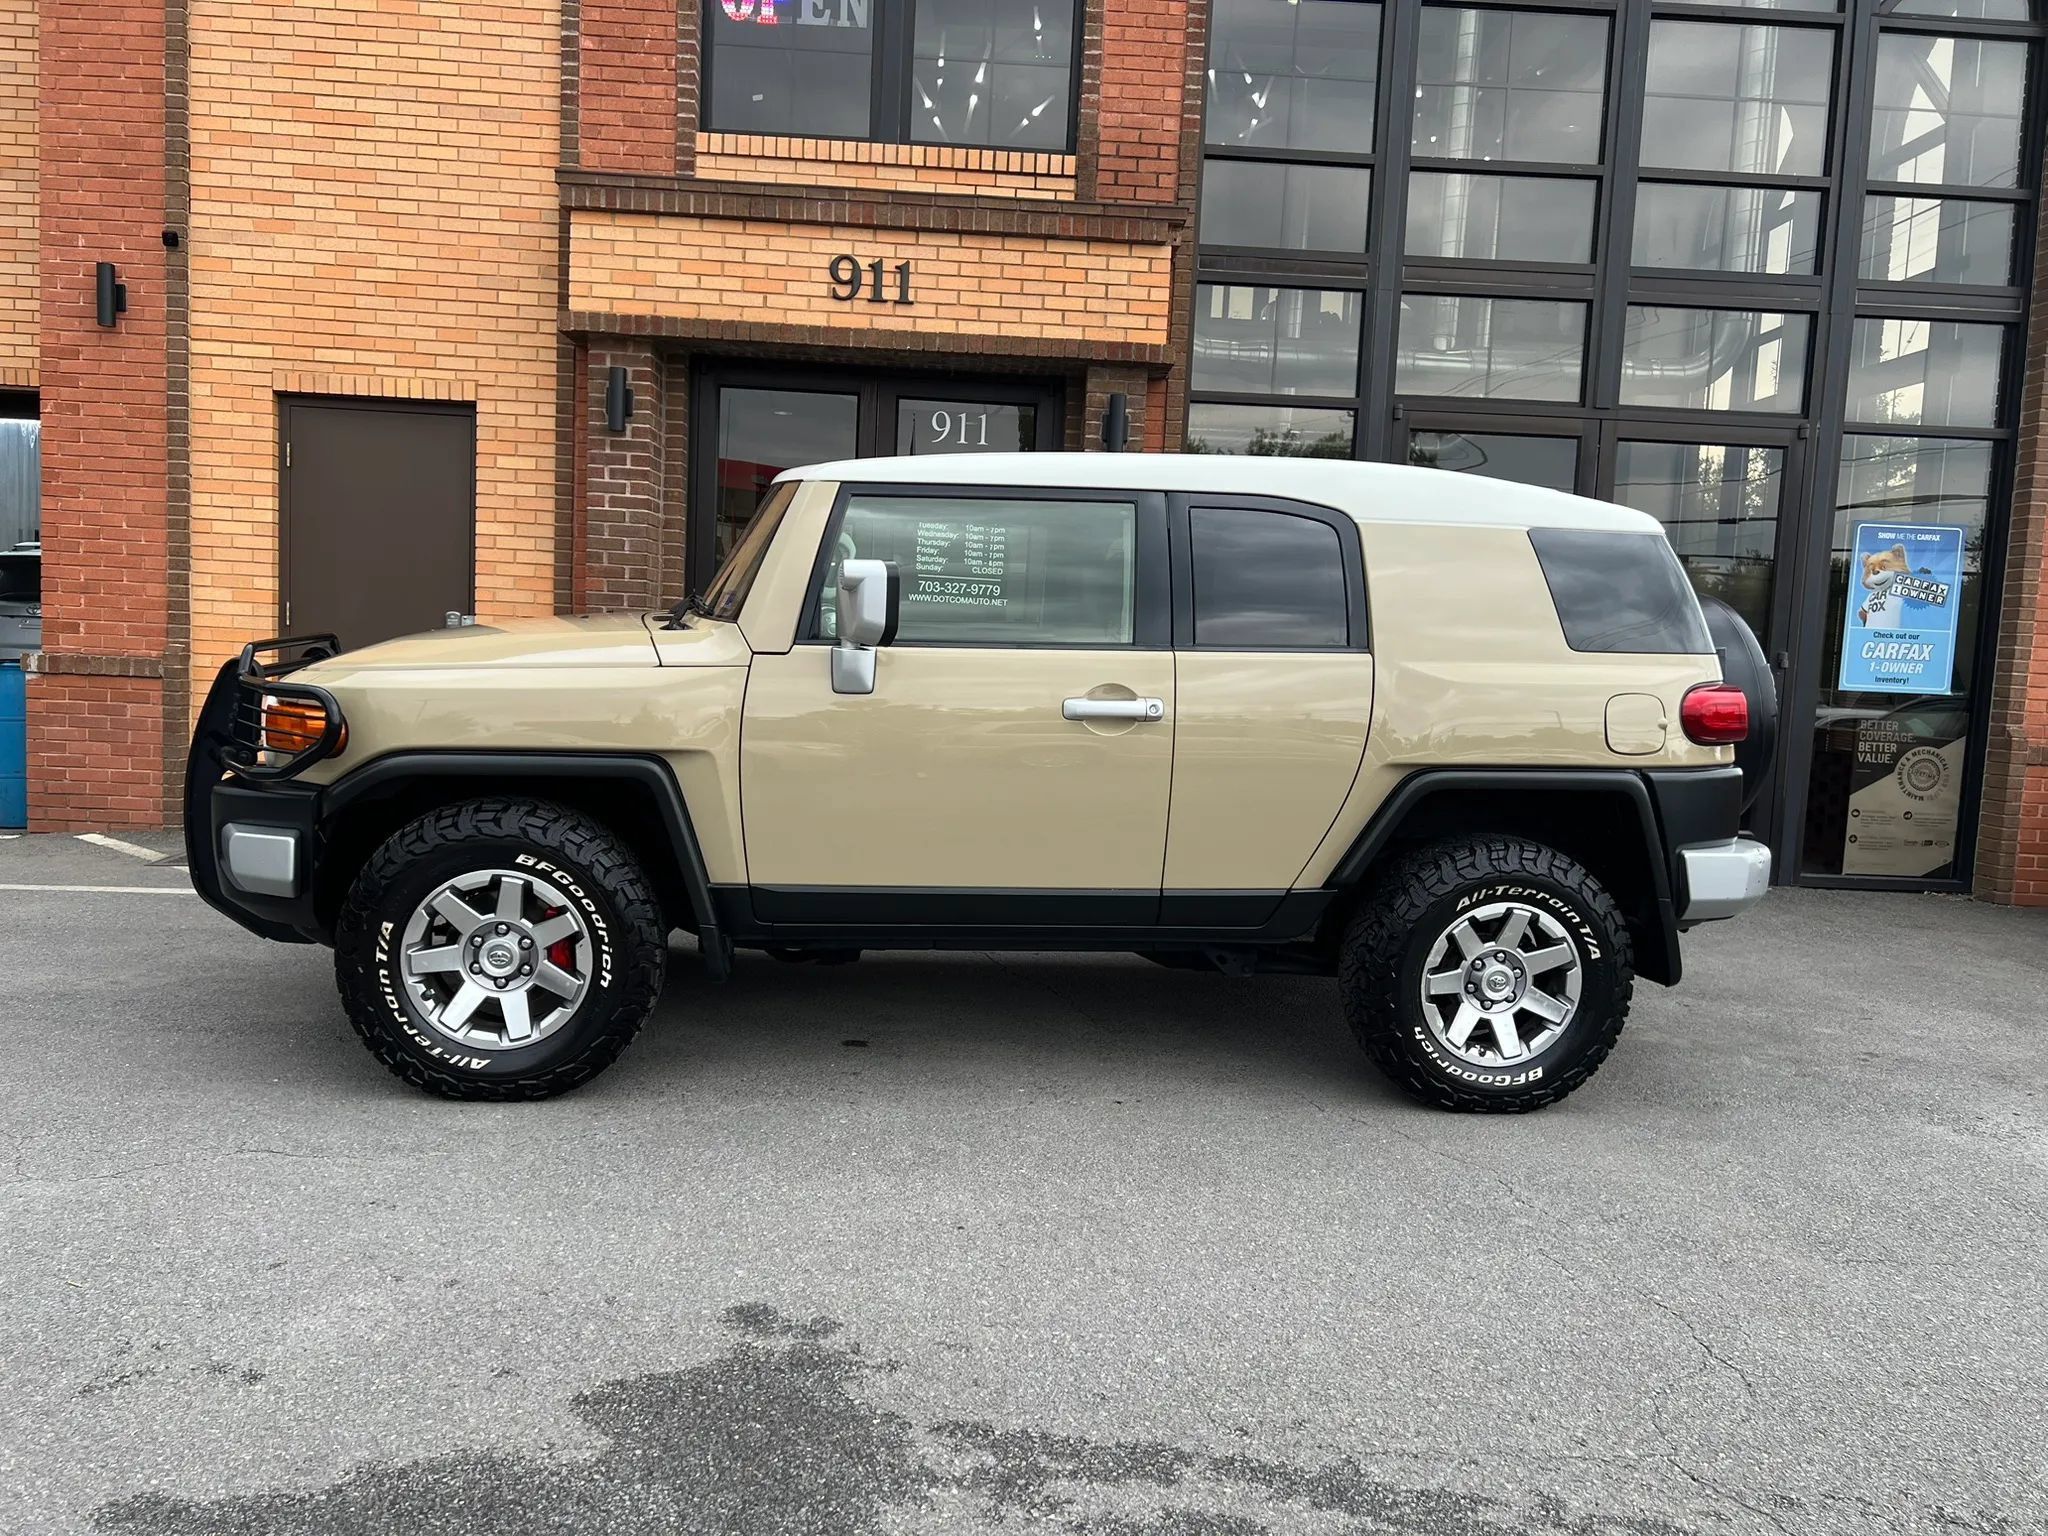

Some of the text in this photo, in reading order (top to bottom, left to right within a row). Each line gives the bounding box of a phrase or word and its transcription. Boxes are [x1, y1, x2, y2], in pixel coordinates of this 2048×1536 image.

[829, 254, 914, 305] 911
[931, 410, 989, 445] 911
[1917, 534, 1941, 542] CARFAX
[972, 567, 1003, 575] CLOSED
[918, 581, 1001, 596] 703-327-9779
[1895, 575, 1948, 595] CARFAX
[908, 594, 1008, 606] WWW.DOTCOMAUTO.NET
[1869, 591, 1888, 602] CAR
[1868, 601, 1886, 613] FOX
[1873, 631, 1894, 640] Check
[1861, 641, 1935, 661] CARFAX
[1869, 662, 1924, 674] 1-OWNER
[1874, 676, 1910, 685] Inventory!
[1860, 720, 1898, 730] BETTER
[1859, 731, 1917, 743] COVERAGE.
[1858, 742, 1897, 753] BETTER
[1858, 753, 1894, 764] VALUE.
[515, 853, 613, 988] BFGoodrich
[1456, 885, 1601, 960] All-Terrain T/A
[375, 921, 492, 1070] All-Terrain T/A
[1413, 1026, 1543, 1086] BFGoodrich
